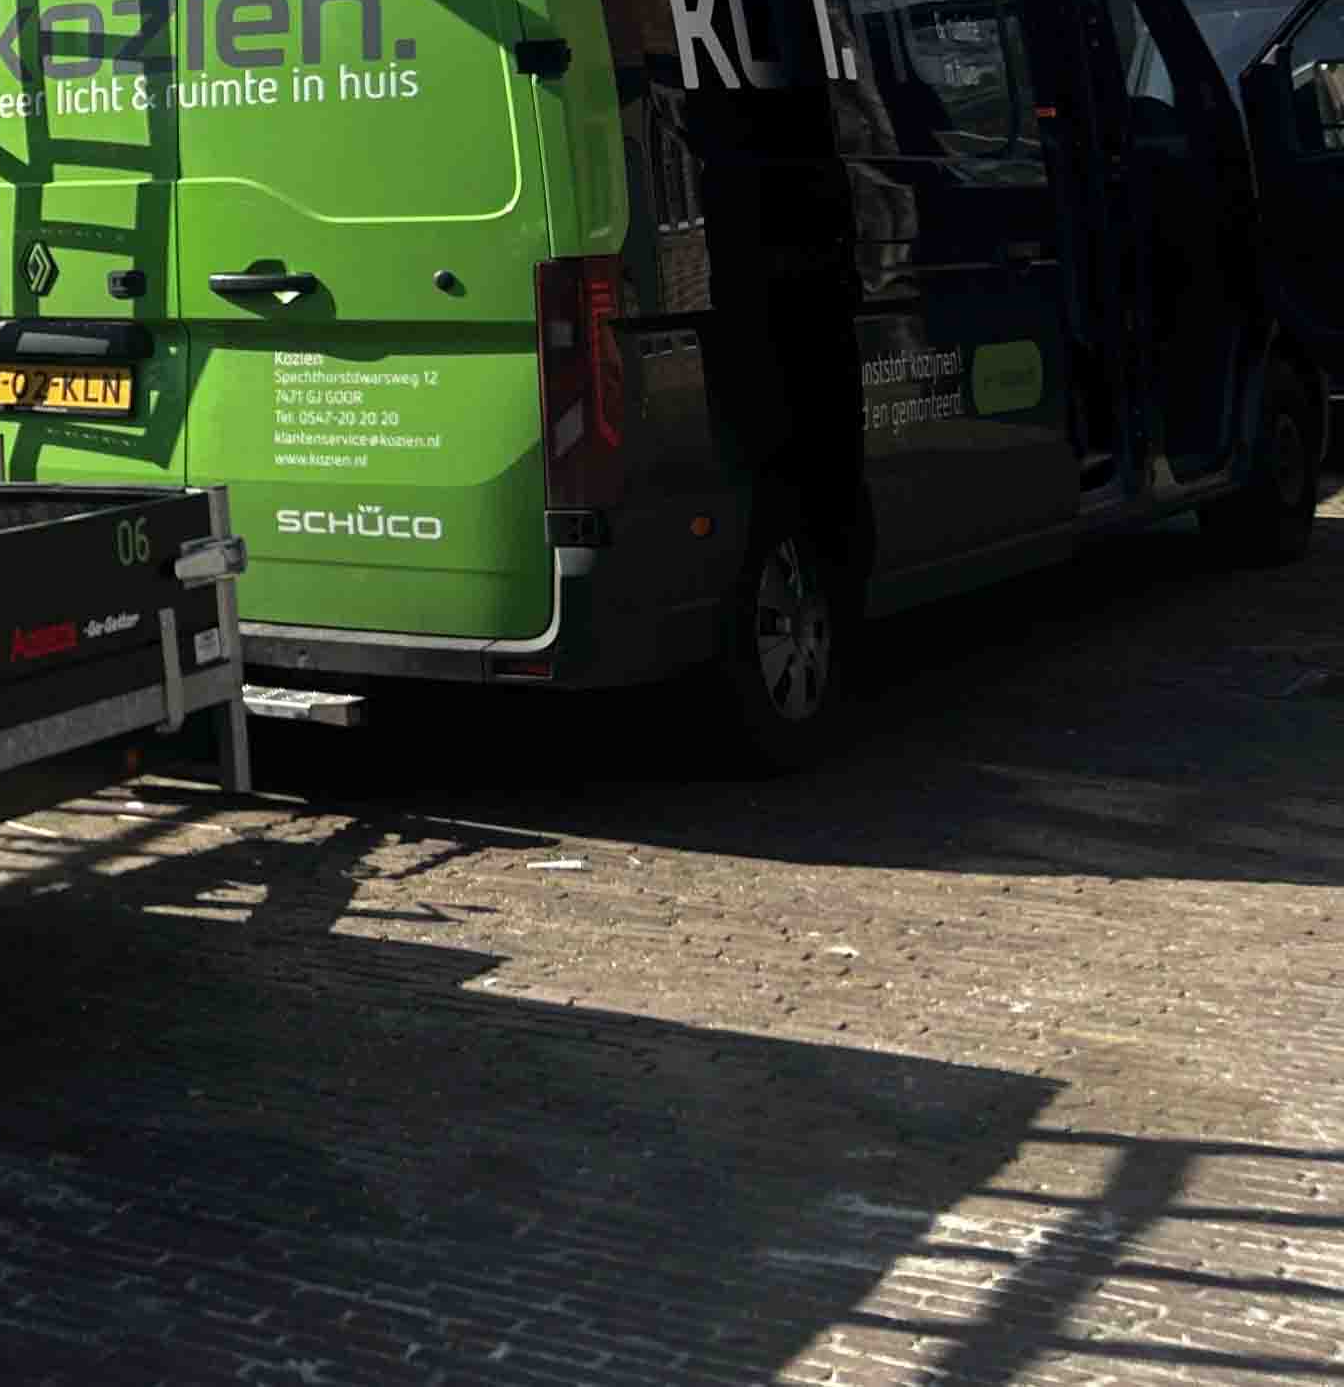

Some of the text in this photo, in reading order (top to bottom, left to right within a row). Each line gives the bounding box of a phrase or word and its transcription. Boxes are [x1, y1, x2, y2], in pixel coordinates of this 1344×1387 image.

[57, 82, 123, 114] licht
[132, 76, 155, 110] &
[166, 69, 278, 109] ruimte
[293, 67, 325, 103] in
[340, 62, 418, 100] huis
[423, 371, 439, 385] 12
[359, 411, 377, 426] 20
[381, 411, 400, 426] 20
[276, 504, 442, 539] SCHÜCO
[117, 517, 151, 565] 06
